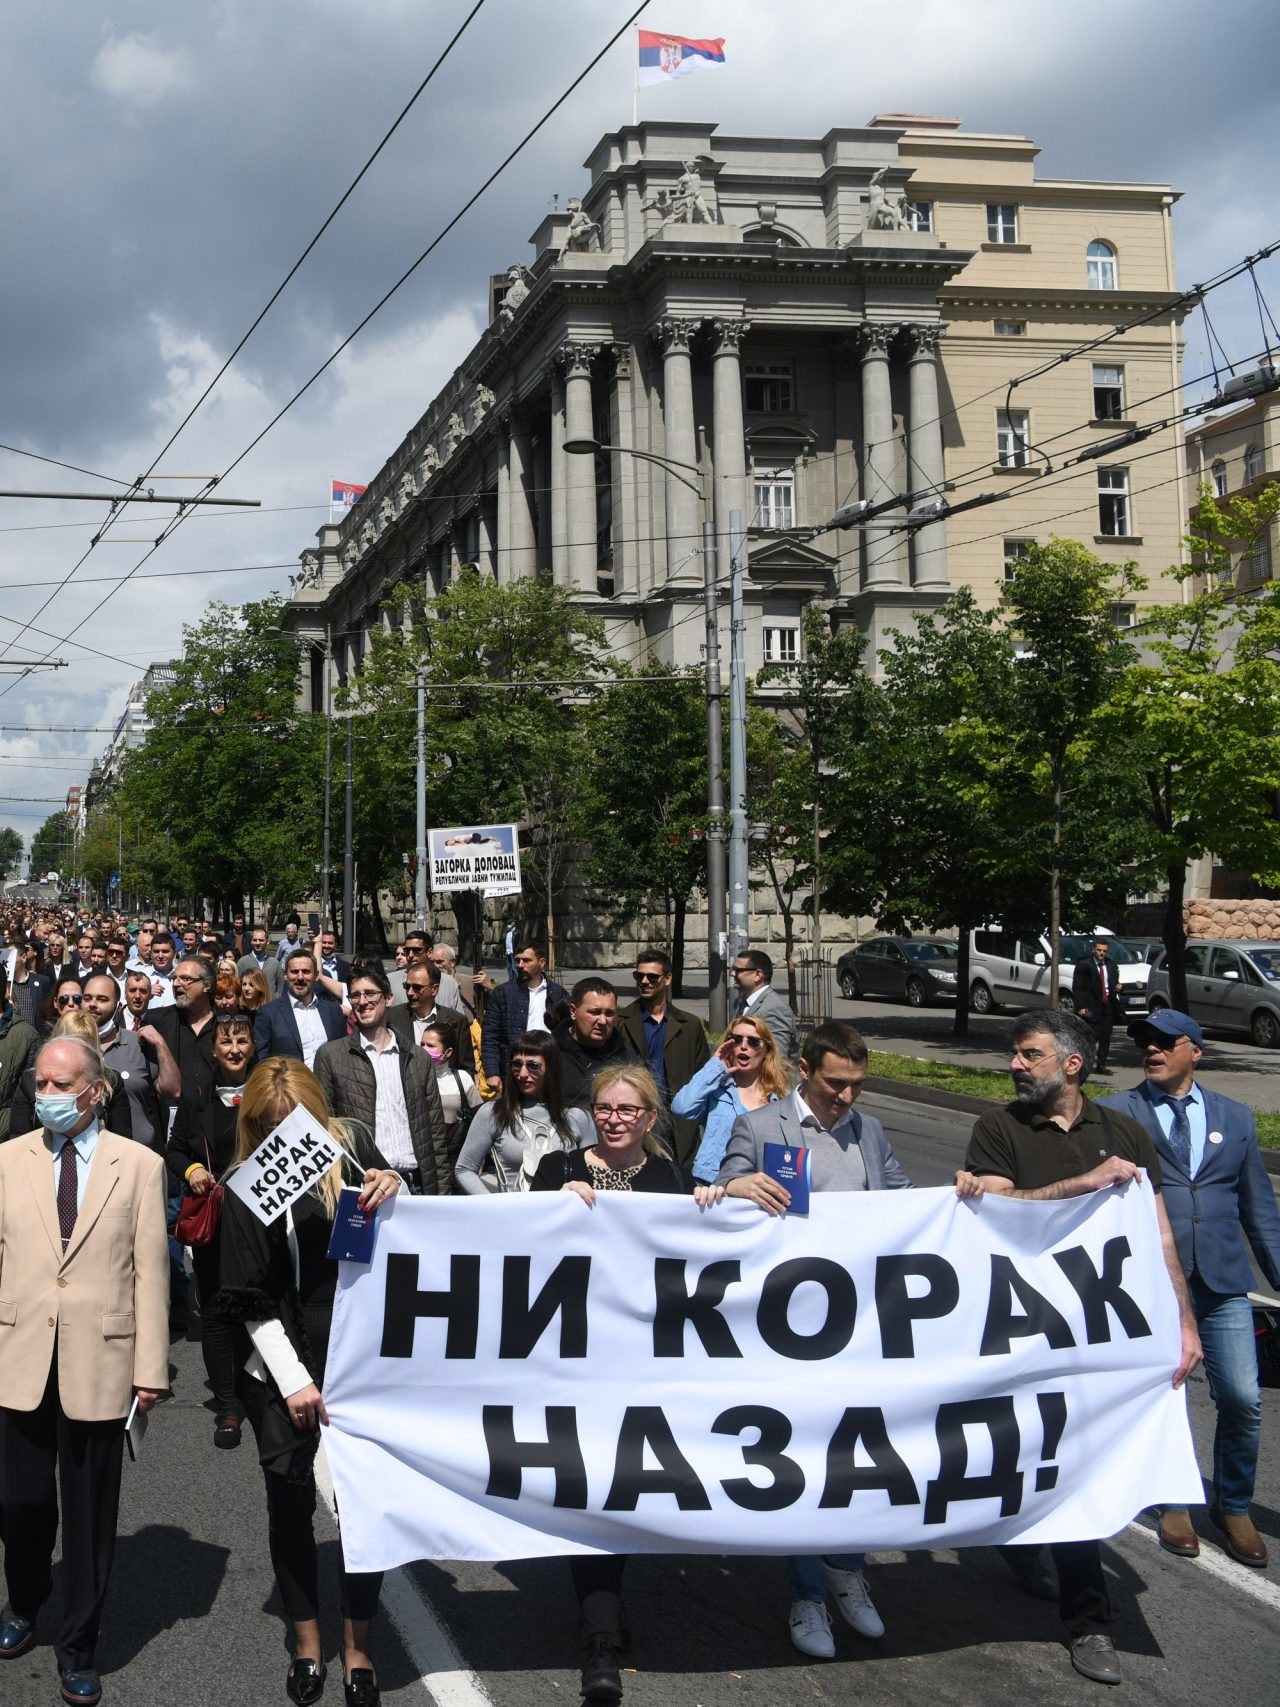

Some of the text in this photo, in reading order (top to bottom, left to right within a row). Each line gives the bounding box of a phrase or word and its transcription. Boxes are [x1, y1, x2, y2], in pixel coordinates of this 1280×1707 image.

[435, 855, 516, 874] ЗАГОРКА ДОЛОВАЦ
[435, 872, 517, 885] РЕПУБЛИЧКИ ЈАВНИ ТУЖИЛАЦ
[250, 1132, 319, 1199] КОРАК
[255, 1134, 287, 1168] НИ
[260, 1143, 336, 1217] НАЗАД!
[379, 1235, 1153, 1361] НИ КОРАК
[482, 1391, 1068, 1526] НАЗАД!
